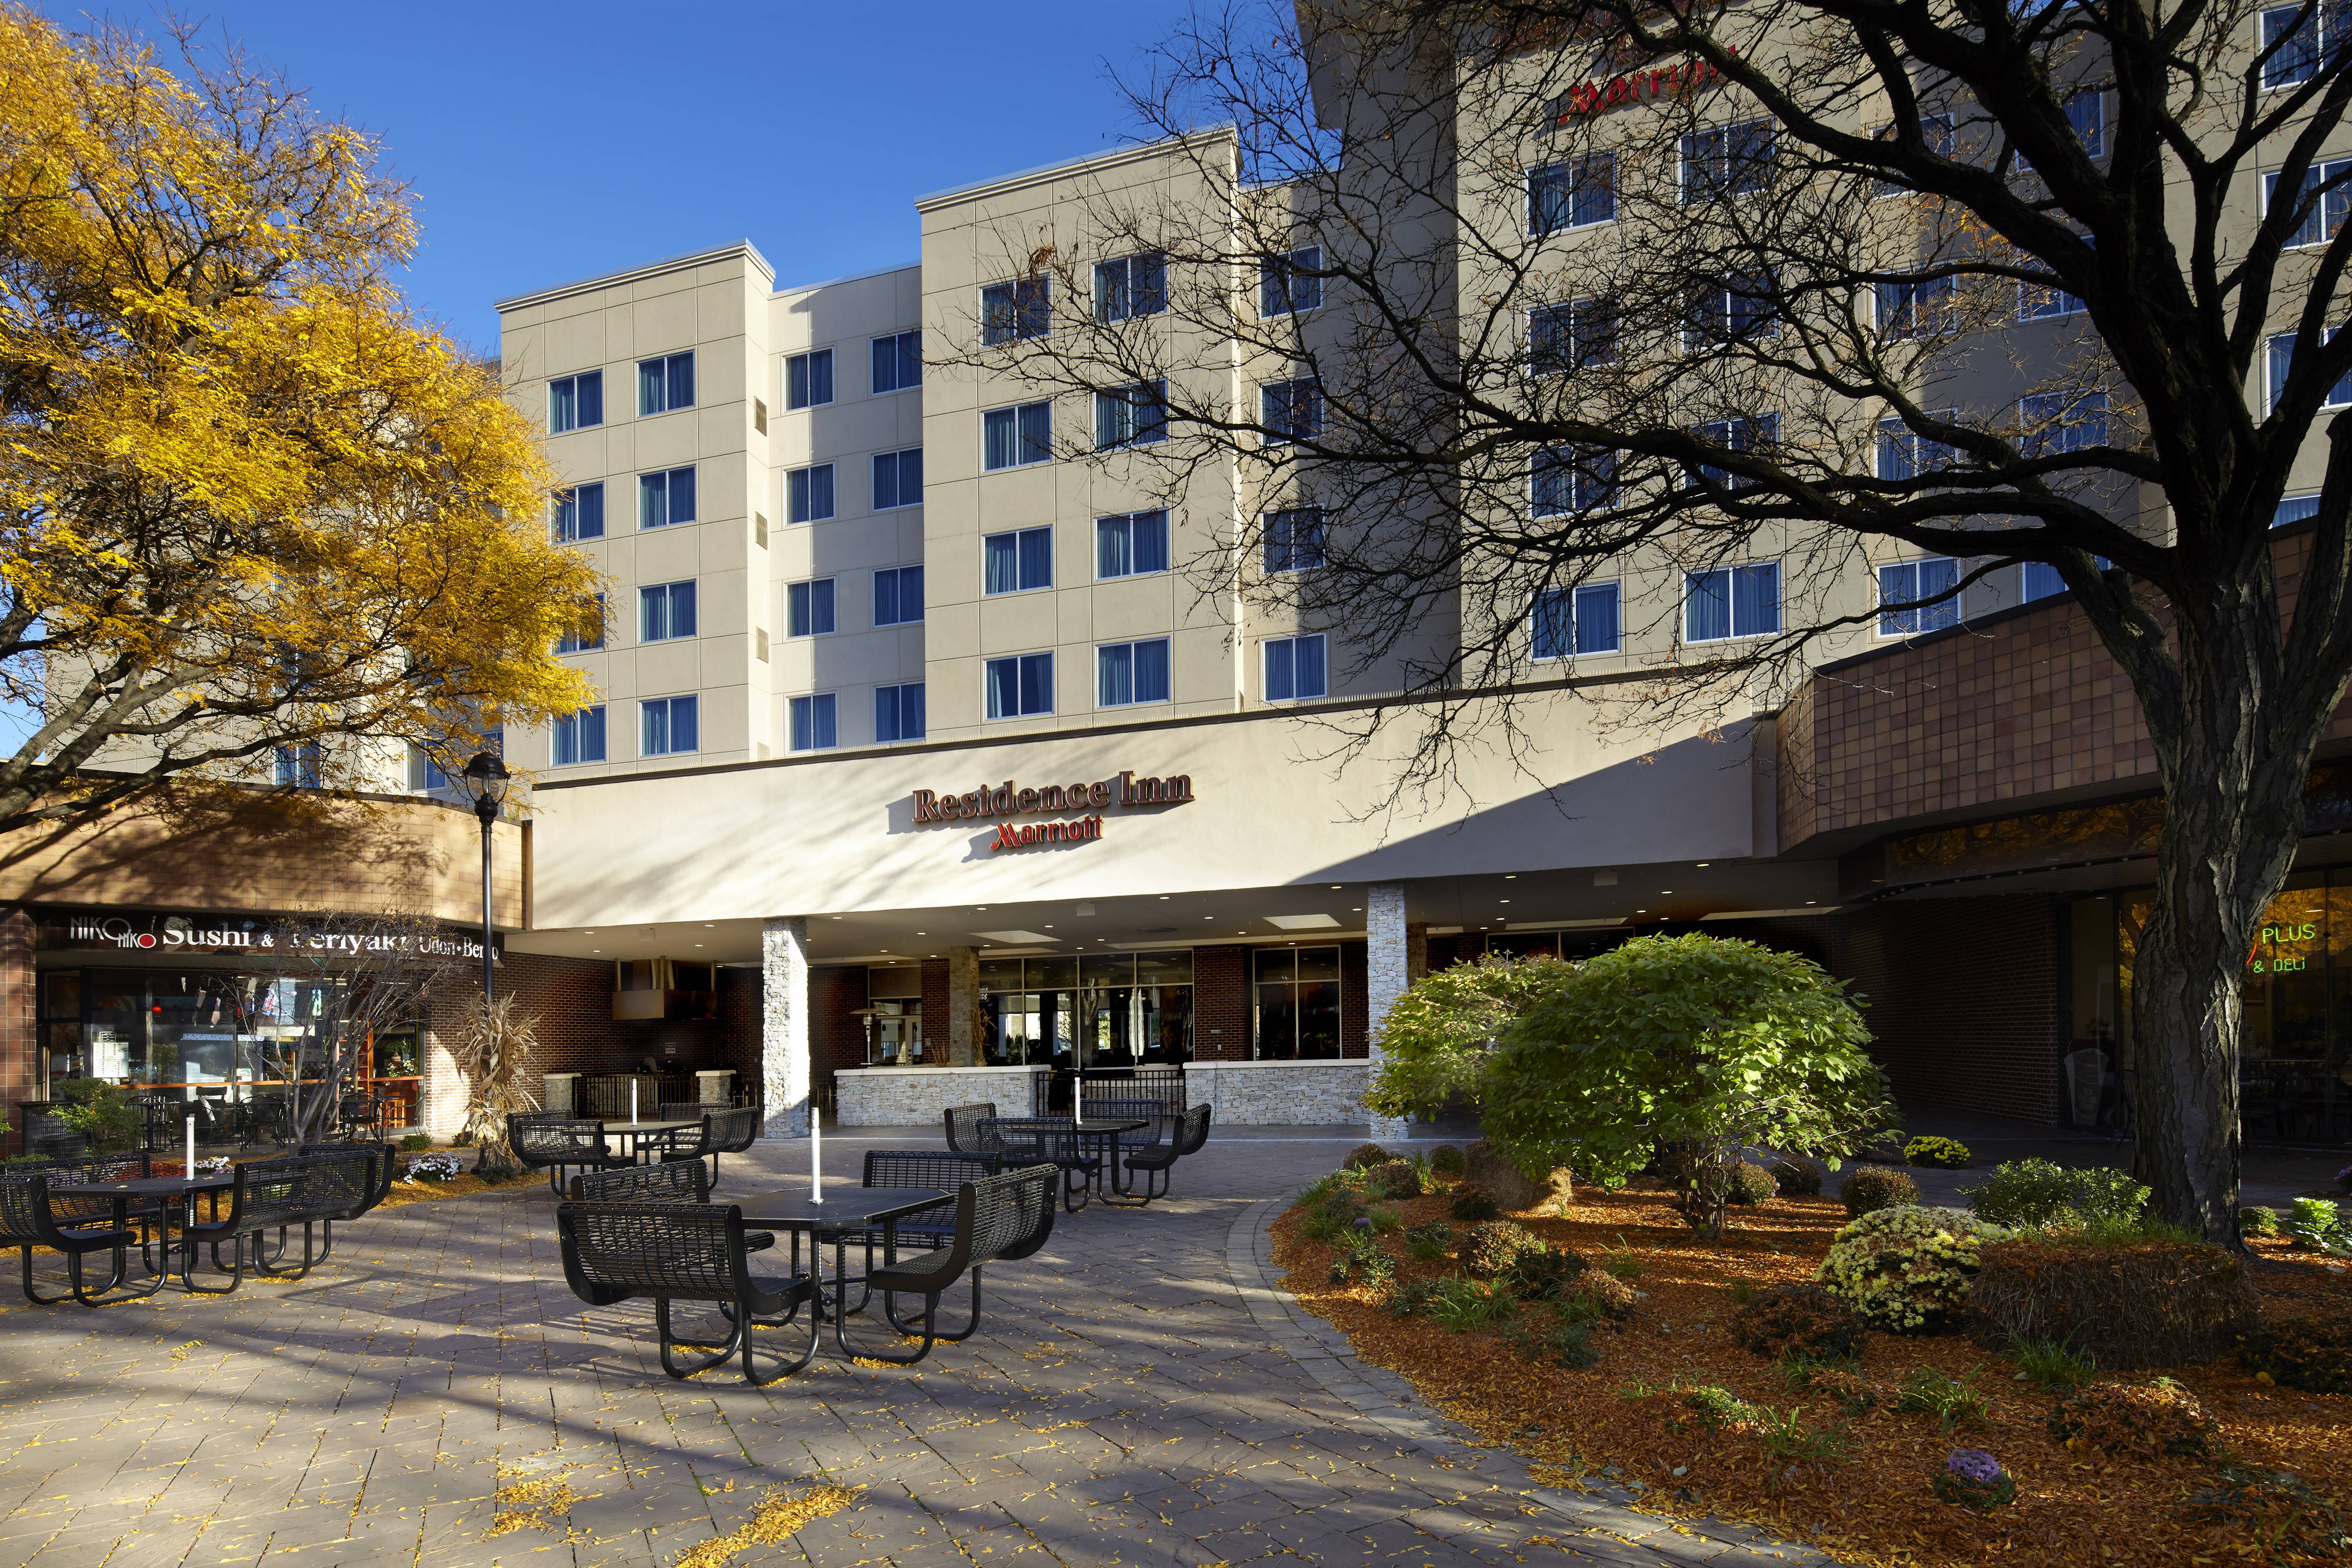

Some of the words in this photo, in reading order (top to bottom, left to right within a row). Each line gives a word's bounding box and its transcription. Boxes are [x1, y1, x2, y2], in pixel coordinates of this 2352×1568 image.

[912, 780, 1111, 823] Residence
[1118, 770, 1197, 805] Inn
[989, 814, 1104, 851] Marriott
[70, 917, 132, 941] NIKO
[118, 932, 157, 949] NIKO
[163, 917, 251, 948] Sushi
[261, 934, 275, 948] &
[2262, 924, 2316, 944] PLUS
[2253, 959, 2265, 974] &
